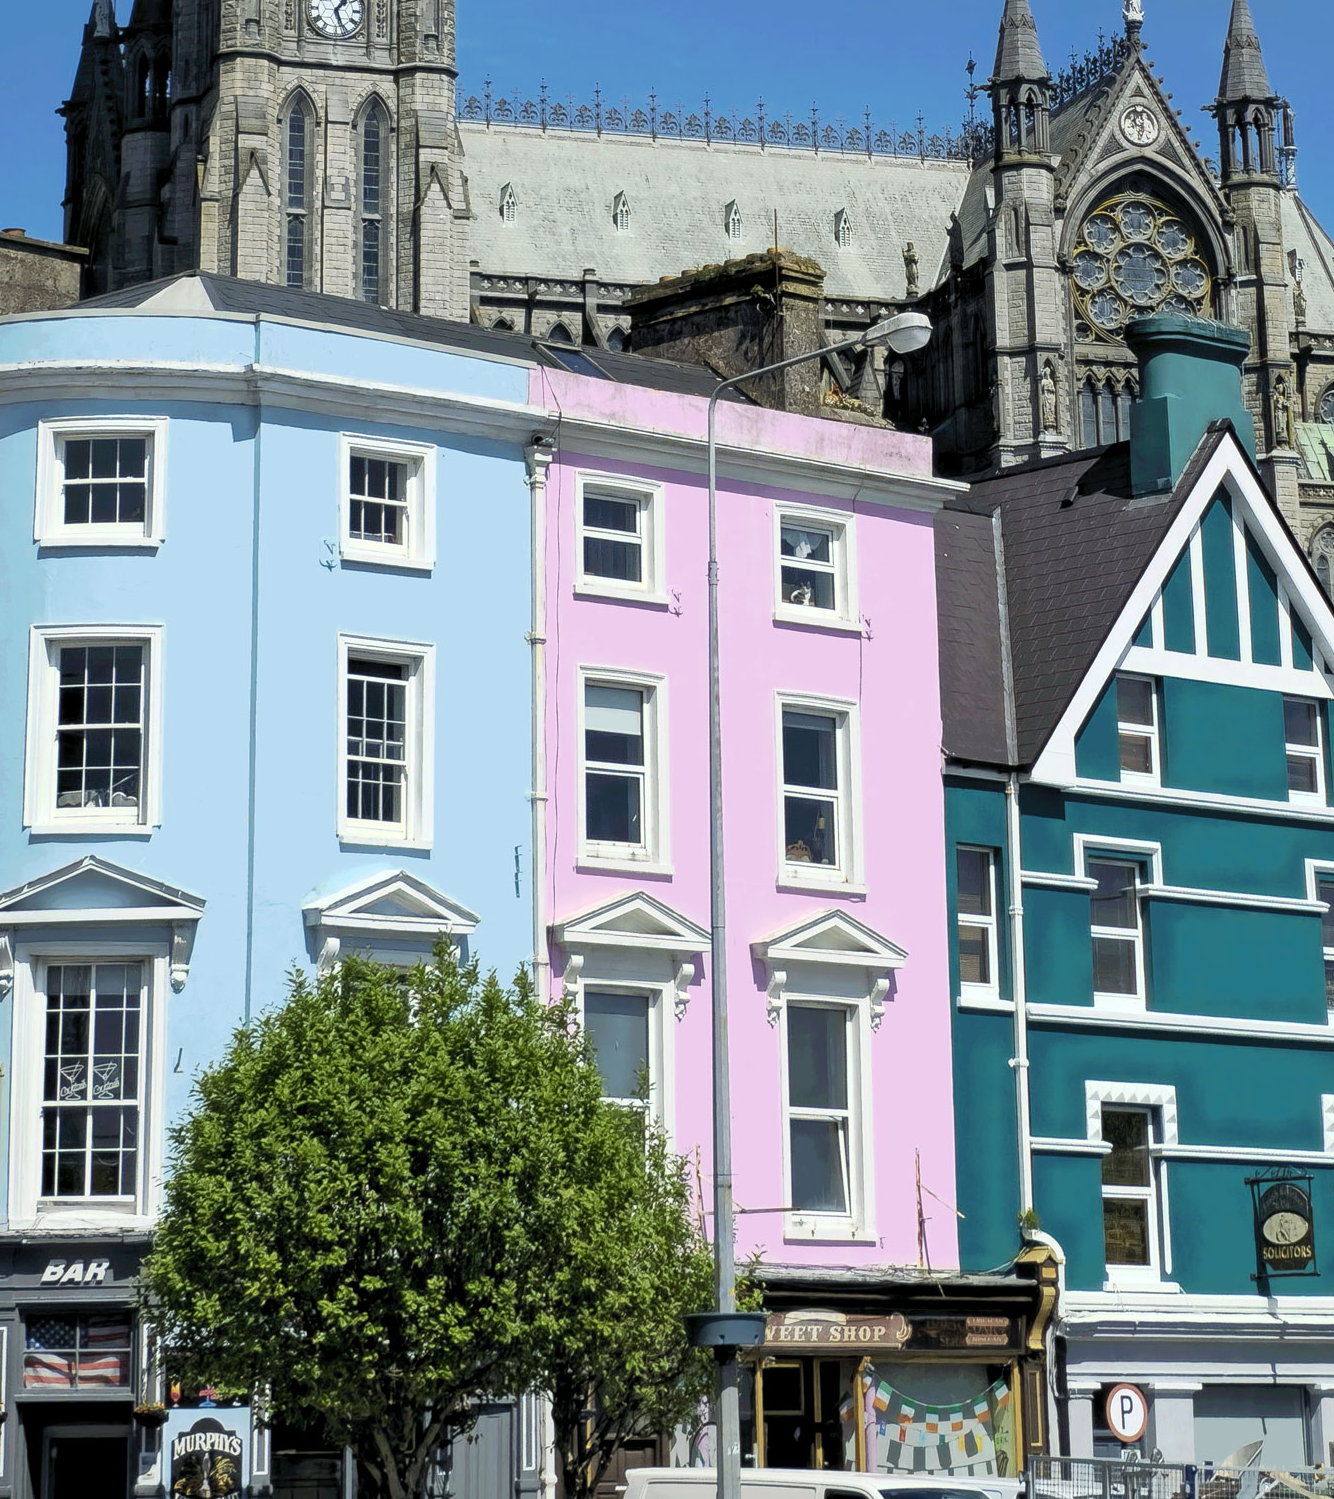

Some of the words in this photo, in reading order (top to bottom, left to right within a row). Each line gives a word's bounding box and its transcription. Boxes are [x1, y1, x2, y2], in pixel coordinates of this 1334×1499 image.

[1263, 1245, 1312, 1259] SOLICITORS
[41, 1258, 110, 1282] BAR
[829, 1325, 887, 1342] SHOP
[1120, 1395, 1133, 1430] P
[173, 1432, 241, 1461] MURPHY'S
